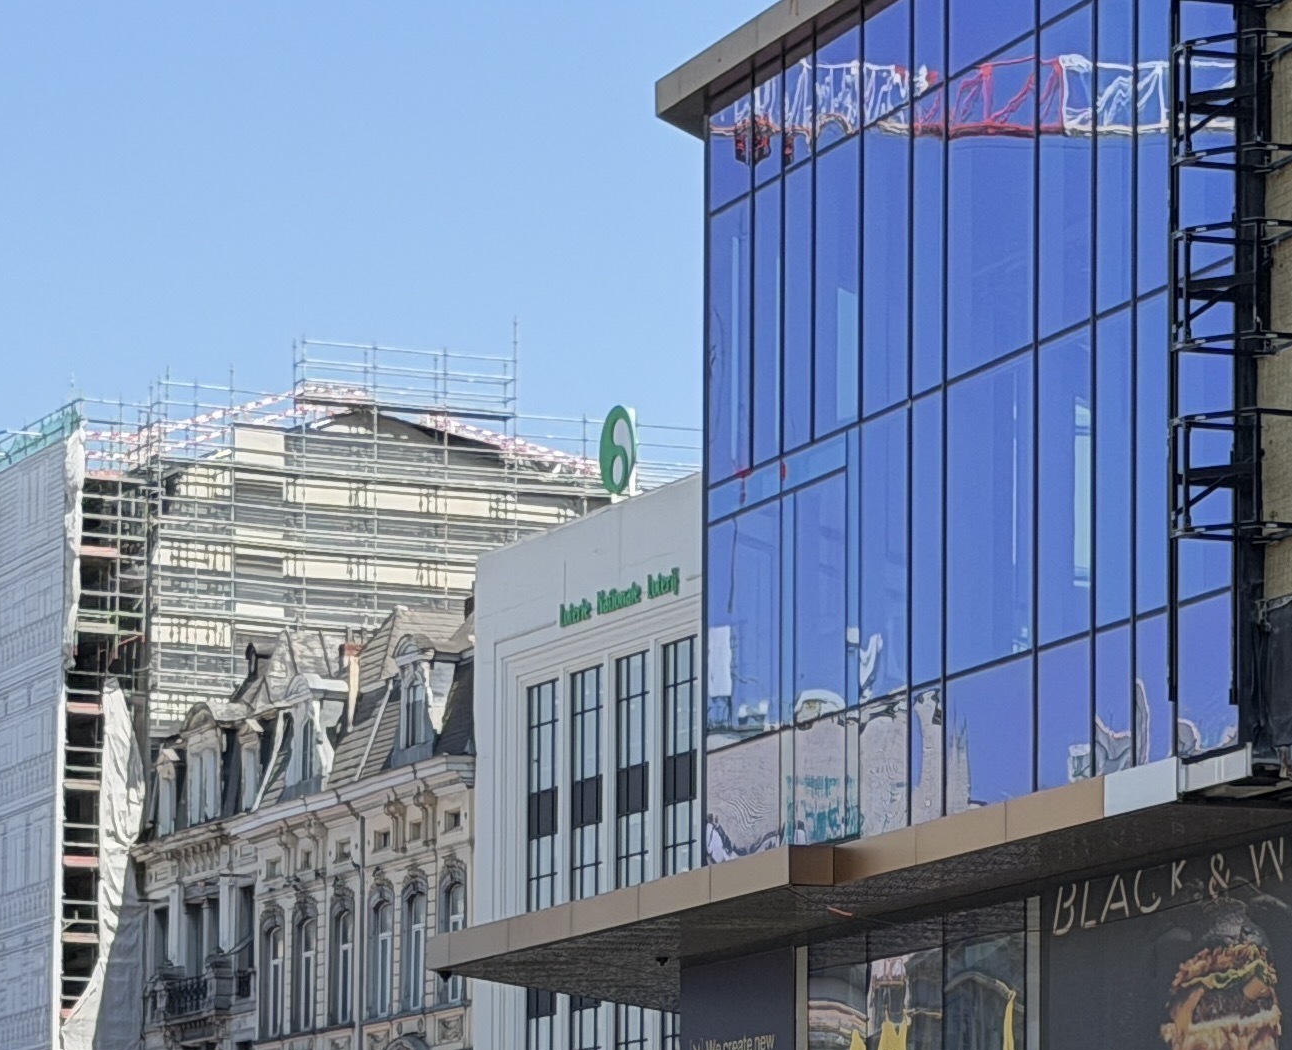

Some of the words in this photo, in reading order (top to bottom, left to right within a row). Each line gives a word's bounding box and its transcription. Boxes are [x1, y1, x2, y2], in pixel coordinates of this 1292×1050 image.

[596, 581, 643, 616] Nationale
[1052, 859, 1187, 937] BLACK
[1208, 852, 1231, 898] &
[754, 1033, 776, 1050] new
